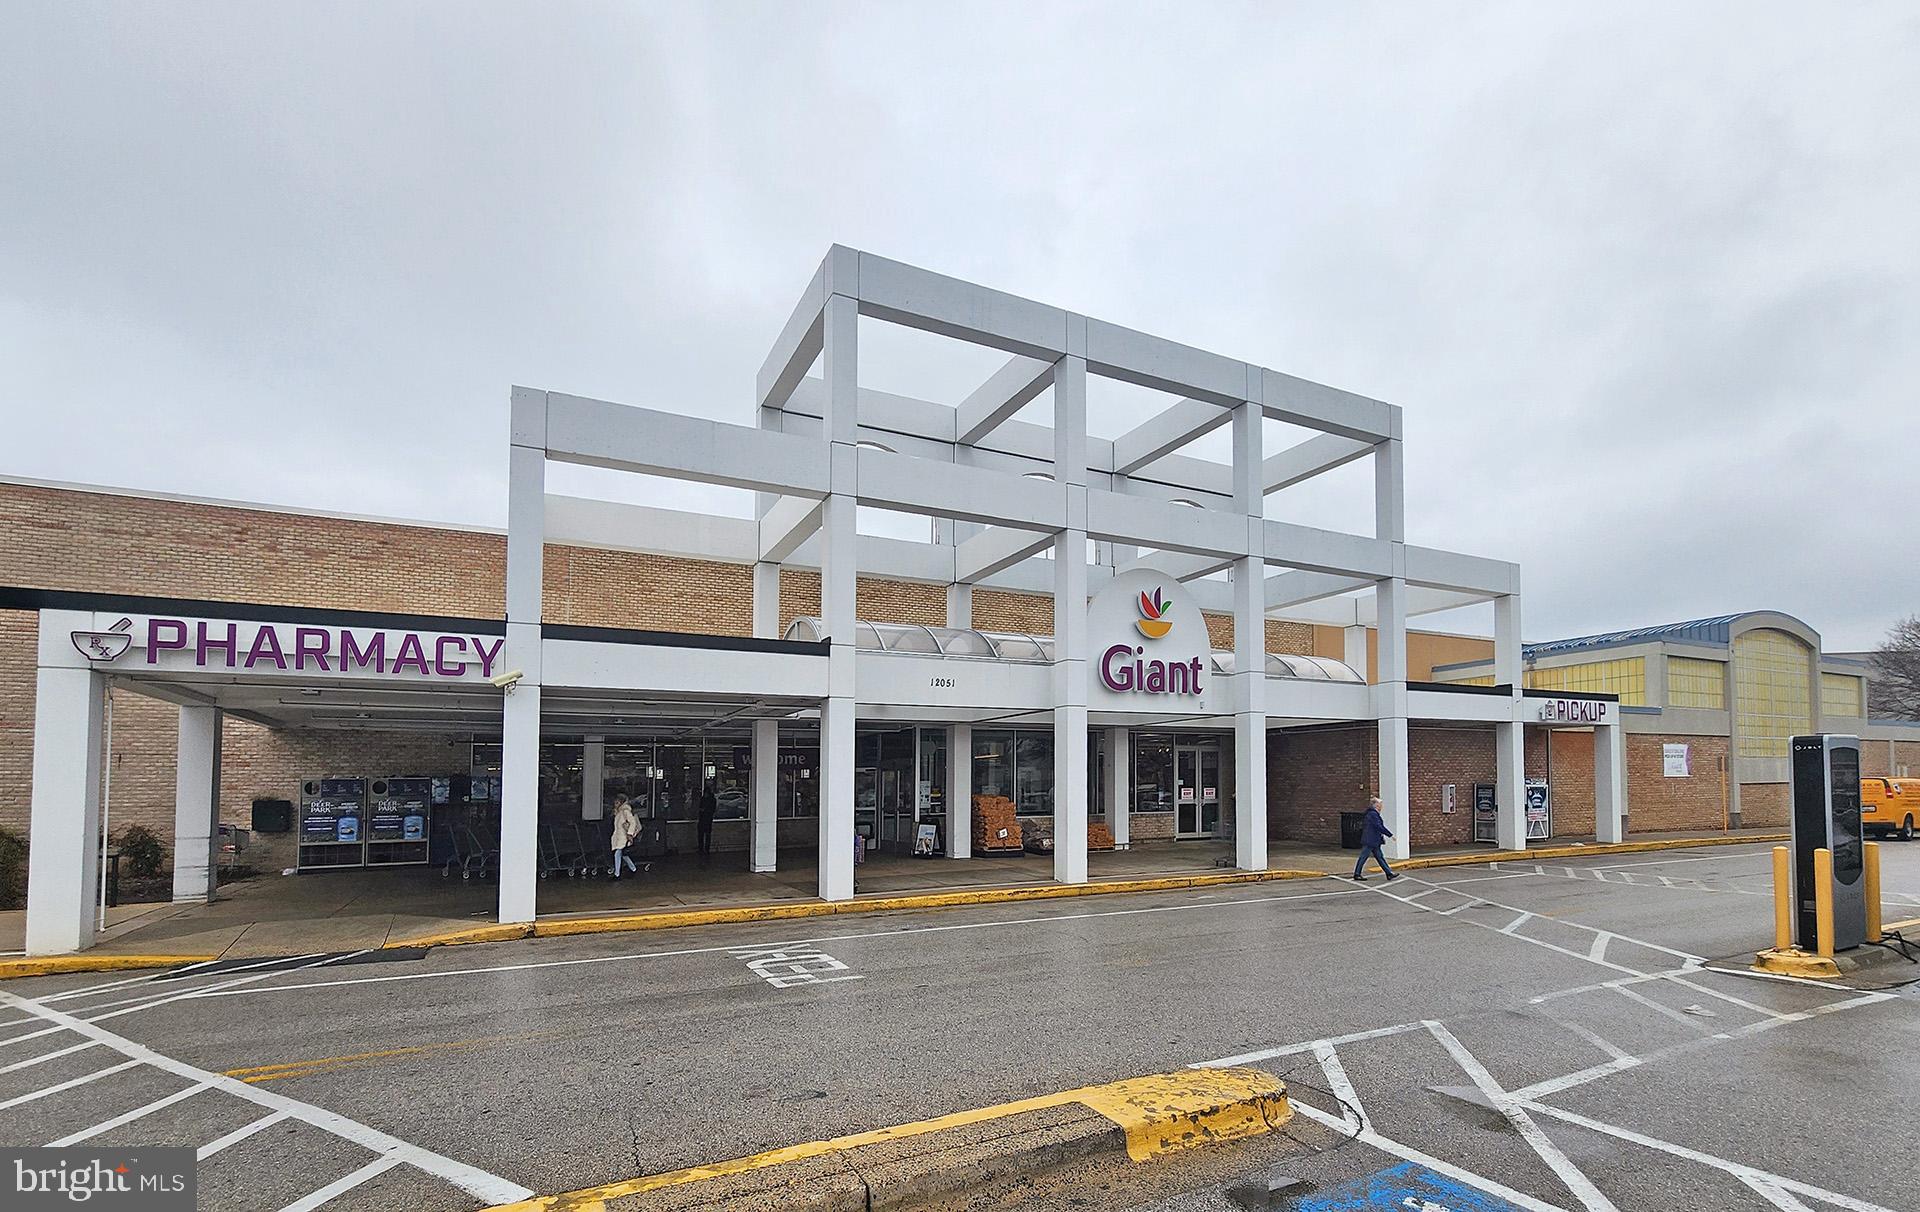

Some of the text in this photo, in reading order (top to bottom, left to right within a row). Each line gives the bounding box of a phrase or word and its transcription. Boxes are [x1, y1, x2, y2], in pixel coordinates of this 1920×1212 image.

[146, 618, 505, 678] PHARMACY
[930, 678, 955, 687] 12051
[1101, 644, 1204, 695] Giant
[1557, 700, 1606, 722] PICKUP
